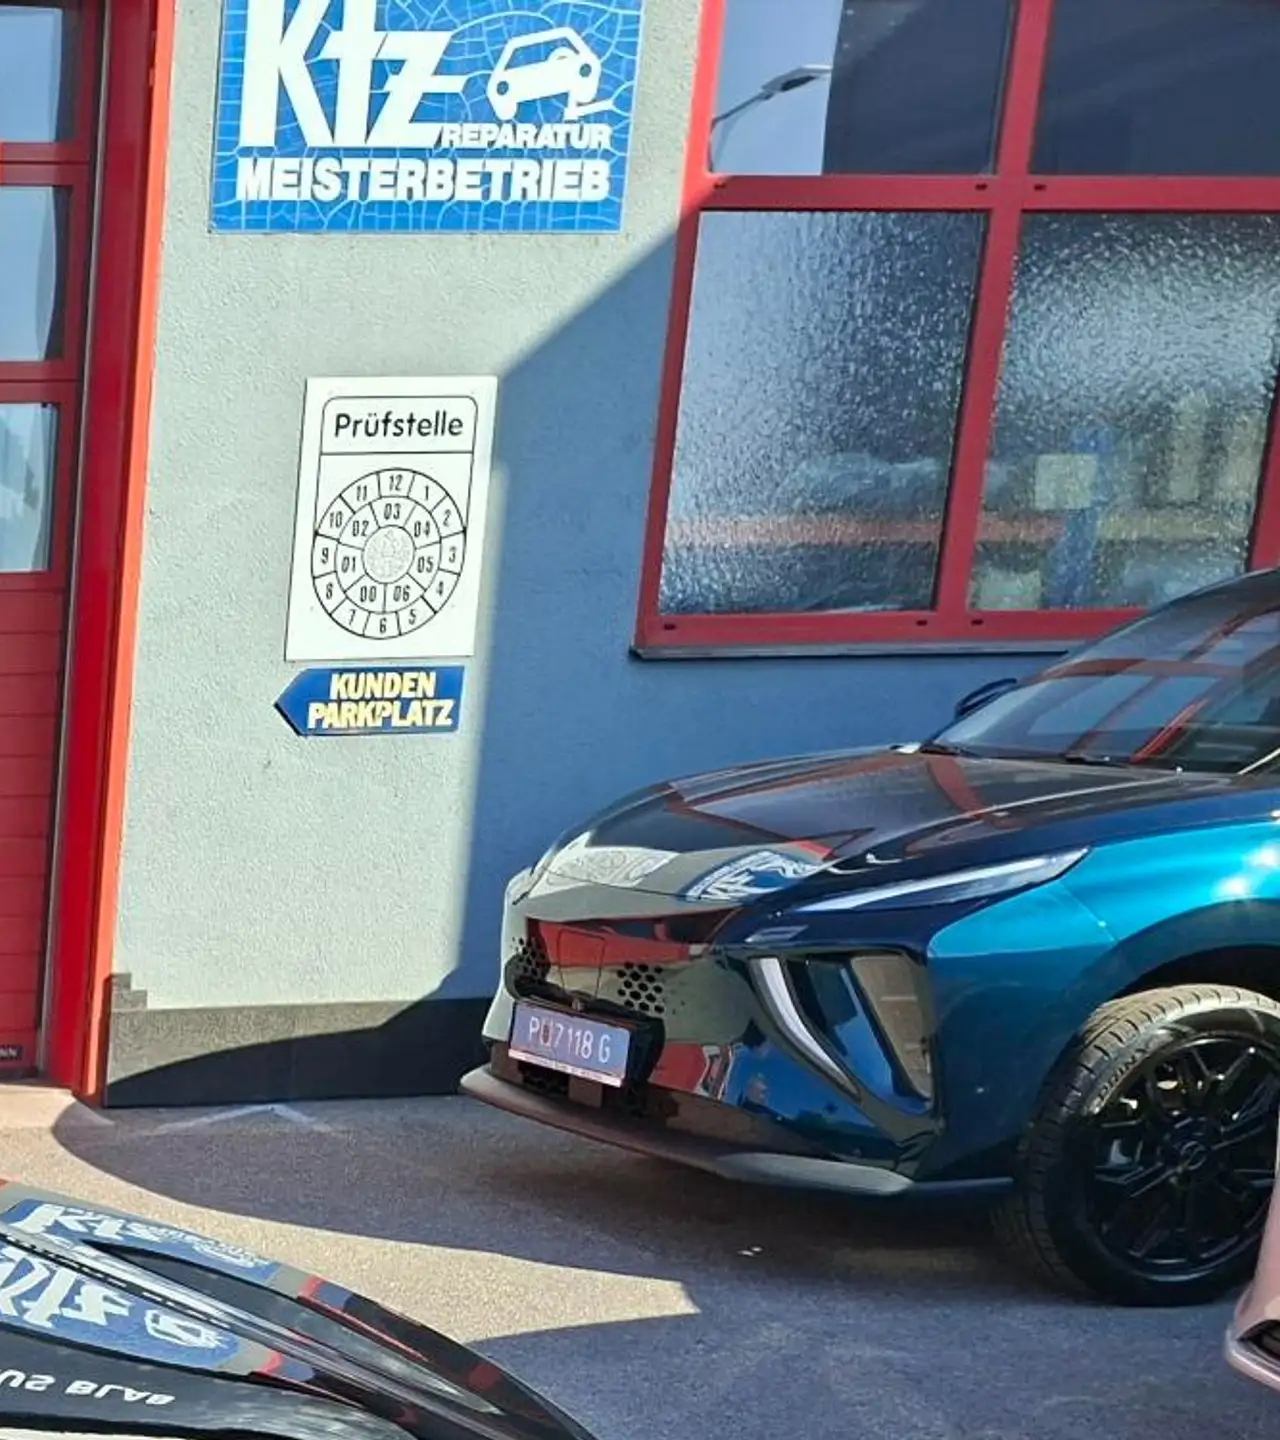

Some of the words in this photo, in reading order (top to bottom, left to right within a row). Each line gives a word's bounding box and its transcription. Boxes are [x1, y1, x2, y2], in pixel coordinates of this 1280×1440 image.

[439, 122, 613, 150] REPARATUR
[236, 156, 612, 202] MEISTERBETRIEB
[335, 411, 464, 441] Prüfstelle
[389, 474, 403, 491] 12
[356, 485, 368, 502] 11
[424, 485, 430, 501] 1
[329, 511, 343, 528] 10
[383, 503, 401, 520] 03
[442, 510, 452, 527] 2
[352, 520, 370, 537] 02
[413, 521, 431, 538] 04
[321, 547, 329, 564] 9
[448, 547, 457, 563] 3
[341, 556, 356, 573] 01
[417, 556, 434, 573] 05
[360, 586, 377, 603] 00
[393, 585, 410, 602] 06
[436, 581, 444, 596] 4
[348, 609, 356, 626] 7
[408, 608, 417, 625] 5
[379, 617, 387, 634] 6
[330, 671, 436, 699] KUNDEN
[307, 699, 454, 730] PARKPLATZ
